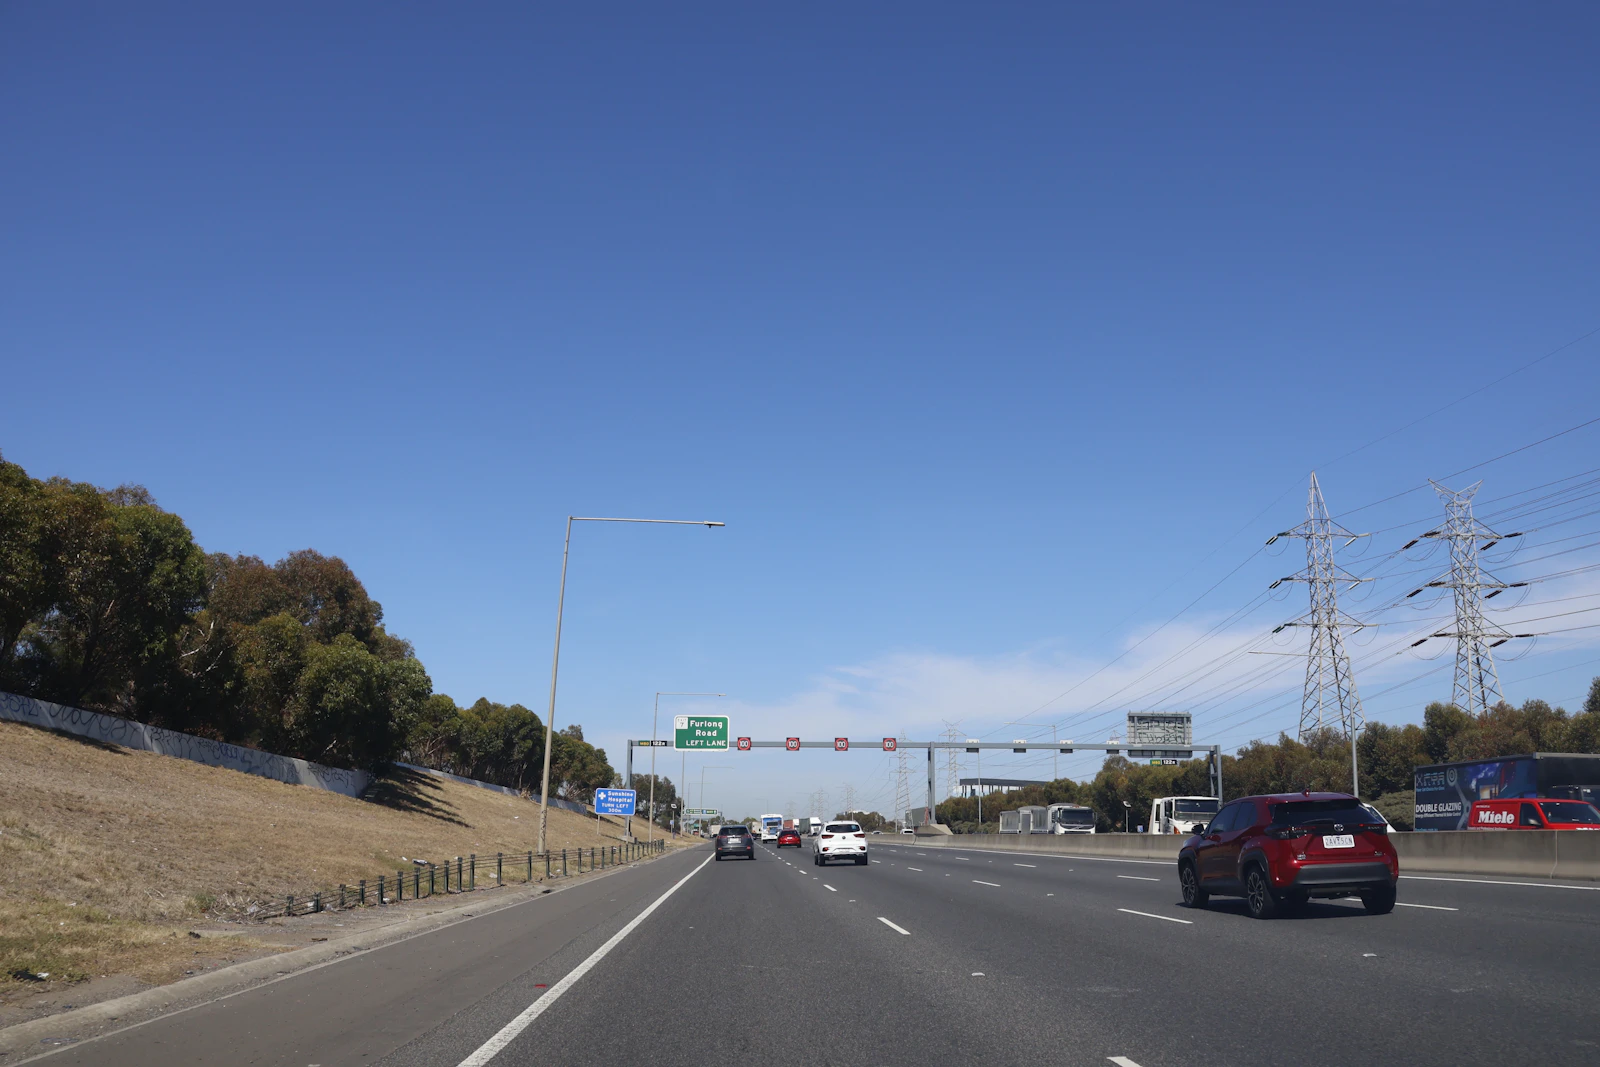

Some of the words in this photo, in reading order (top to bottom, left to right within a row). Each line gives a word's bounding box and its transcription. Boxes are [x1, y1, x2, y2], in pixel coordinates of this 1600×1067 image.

[690, 720, 723, 729] Furlong
[695, 729, 717, 737] Road
[1416, 804, 1438, 812] DOUBLE
[1438, 802, 1461, 812] GLAZING
[1478, 811, 1515, 824] Miele
